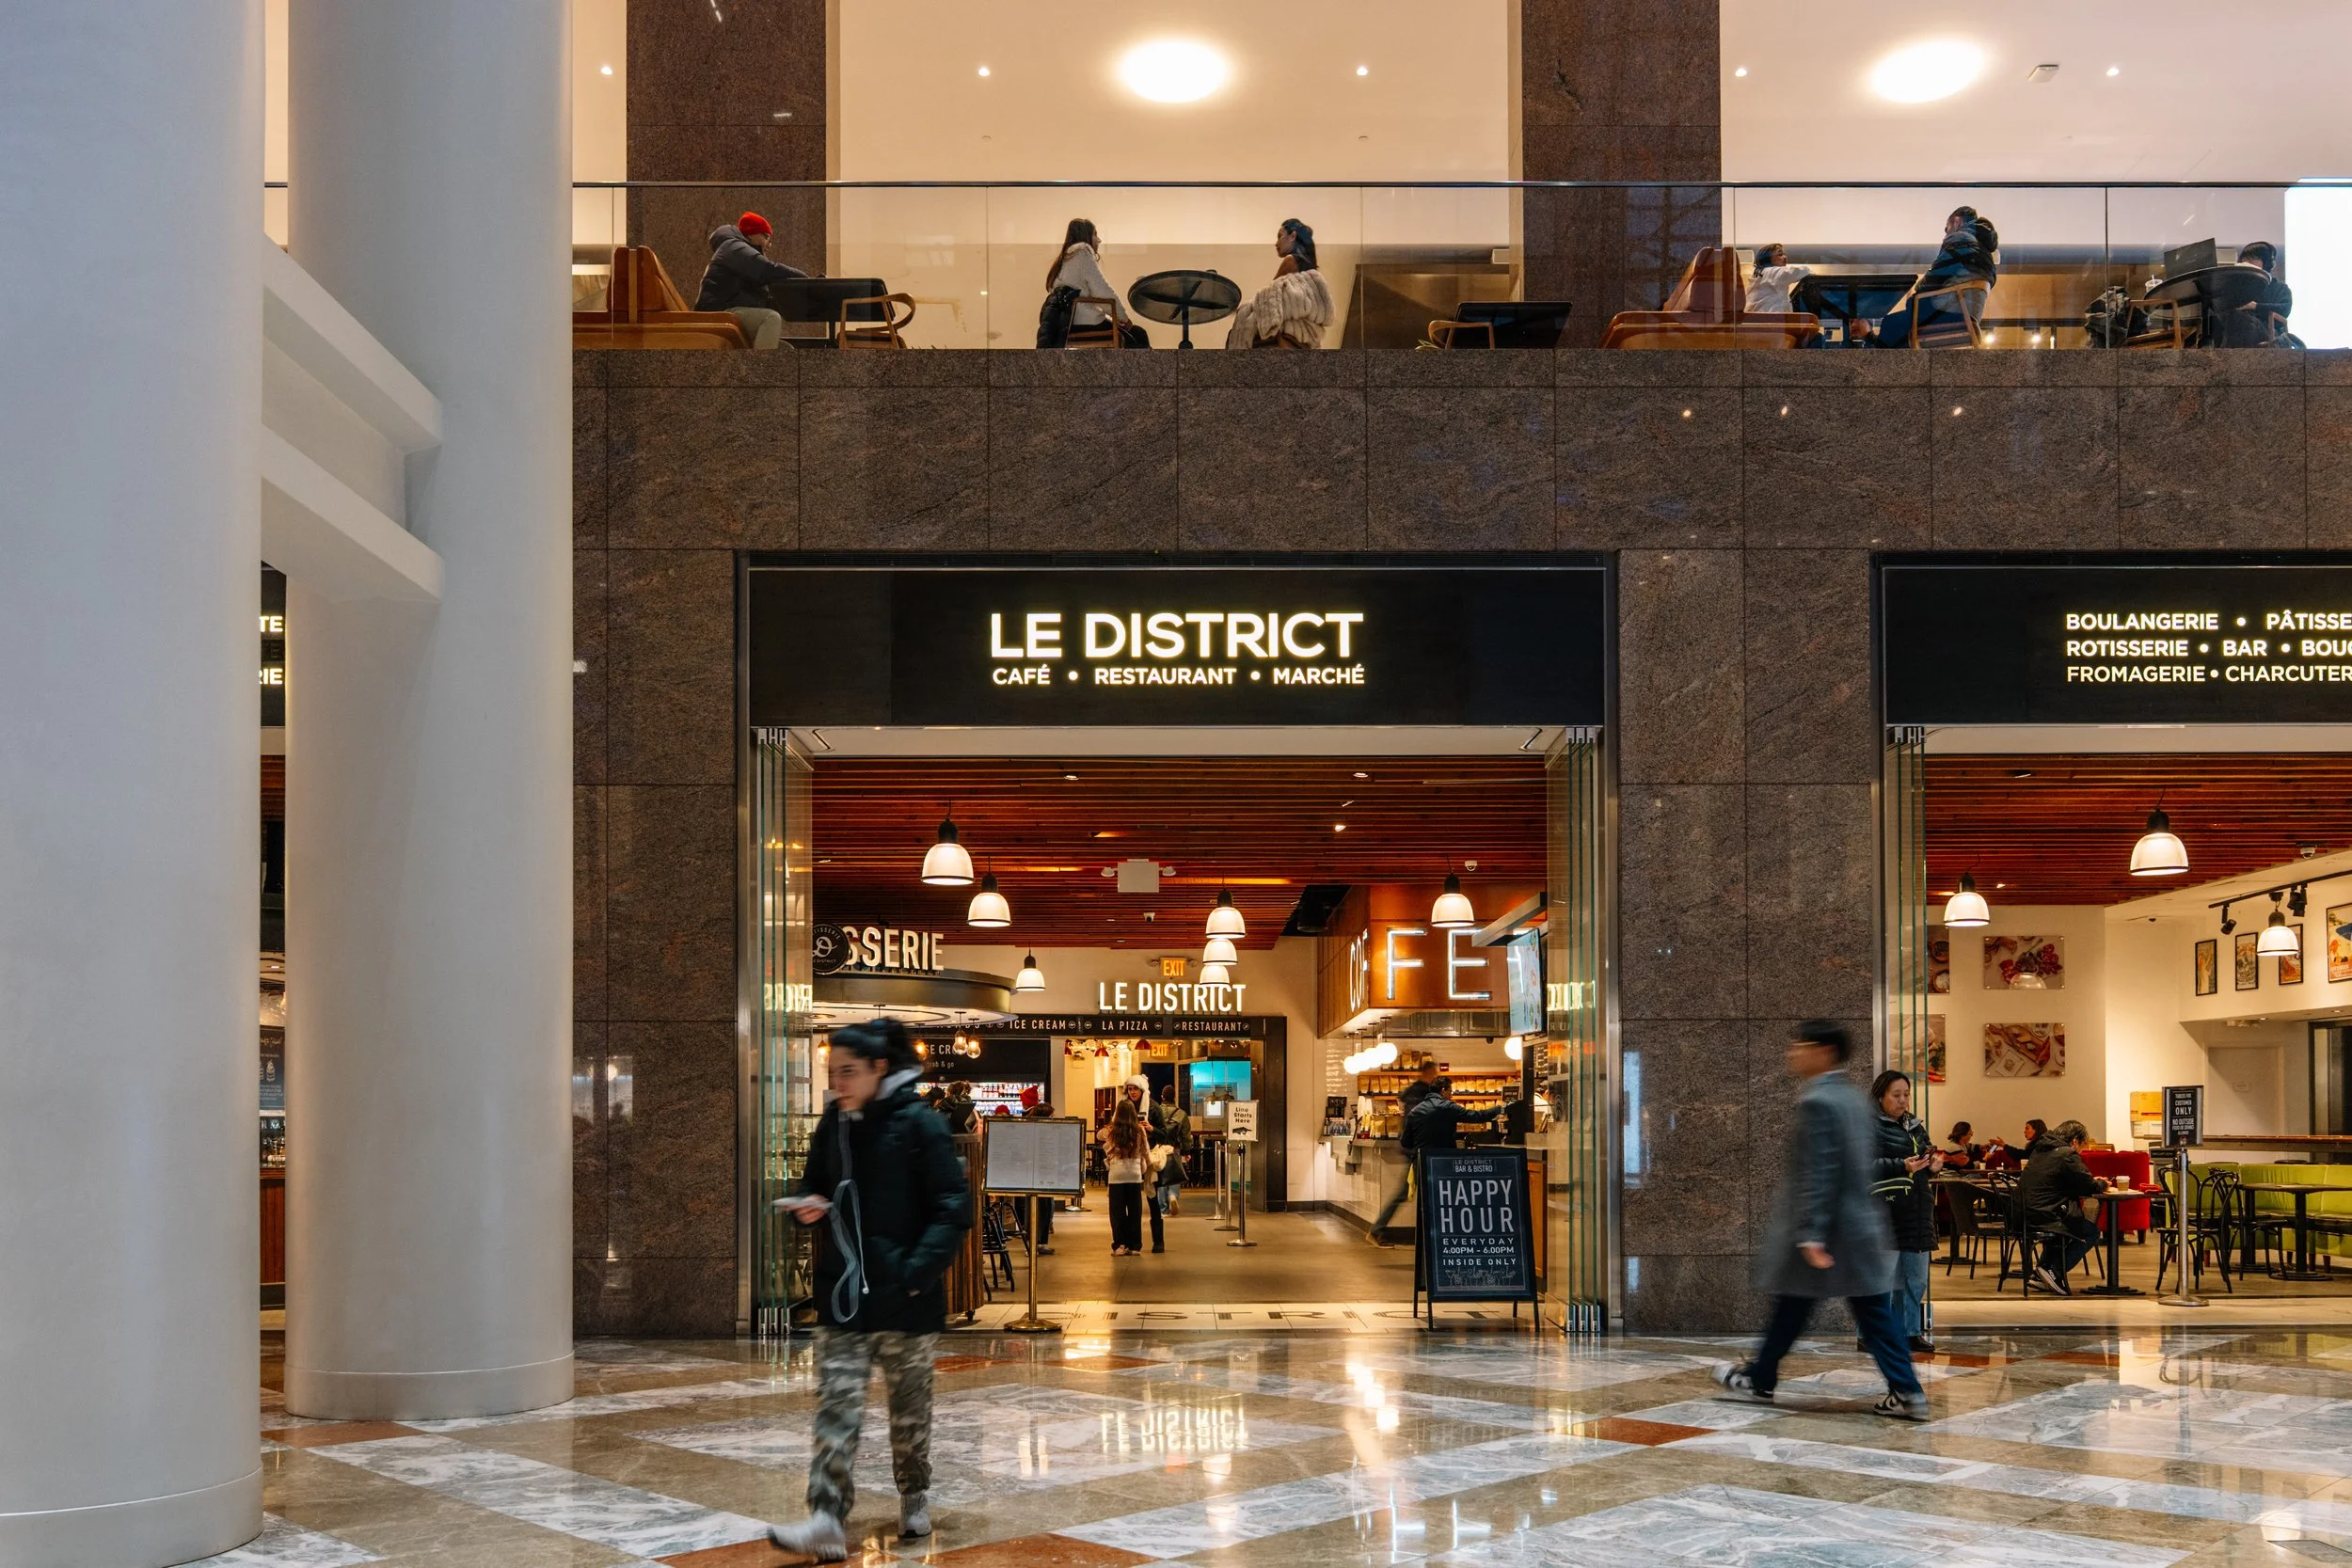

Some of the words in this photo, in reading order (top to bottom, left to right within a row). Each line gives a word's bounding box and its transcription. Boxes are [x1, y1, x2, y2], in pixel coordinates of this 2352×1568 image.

[2066, 613, 2218, 630] BOULANGERIE
[2266, 610, 2352, 630] PÂTISSE
[991, 612, 1062, 658] LE
[1085, 612, 1364, 658] DISTRICT
[2067, 640, 2188, 657] ROTISSERIE
[2222, 640, 2267, 657] BAR
[993, 664, 1051, 685] CAFÉ
[1094, 668, 1237, 685] RESTAURANT
[1273, 664, 1364, 685] MARCHÉ
[2067, 666, 2205, 682] FROMAGERIE
[1163, 959, 1185, 976] EXIT
[1099, 982, 1128, 1011] LE
[1138, 983, 1247, 1012] DISTRICT
[1009, 1020, 1026, 1030] ICE
[1031, 1020, 1066, 1030] CREAM
[1102, 1021, 1114, 1031] LA
[1120, 1021, 1148, 1031] PIZZA
[1182, 1022, 1242, 1031] RESTAURANT
[1152, 1044, 1168, 1056] EXIT
[1454, 1164, 1467, 1173] BAR
[1467, 1164, 1472, 1173] &
[1472, 1164, 1493, 1173] BISTRO
[1438, 1180, 1513, 1206] HAPPY
[1439, 1207, 1515, 1233] HOUR
[1487, 1258, 1517, 1266] ONLY
